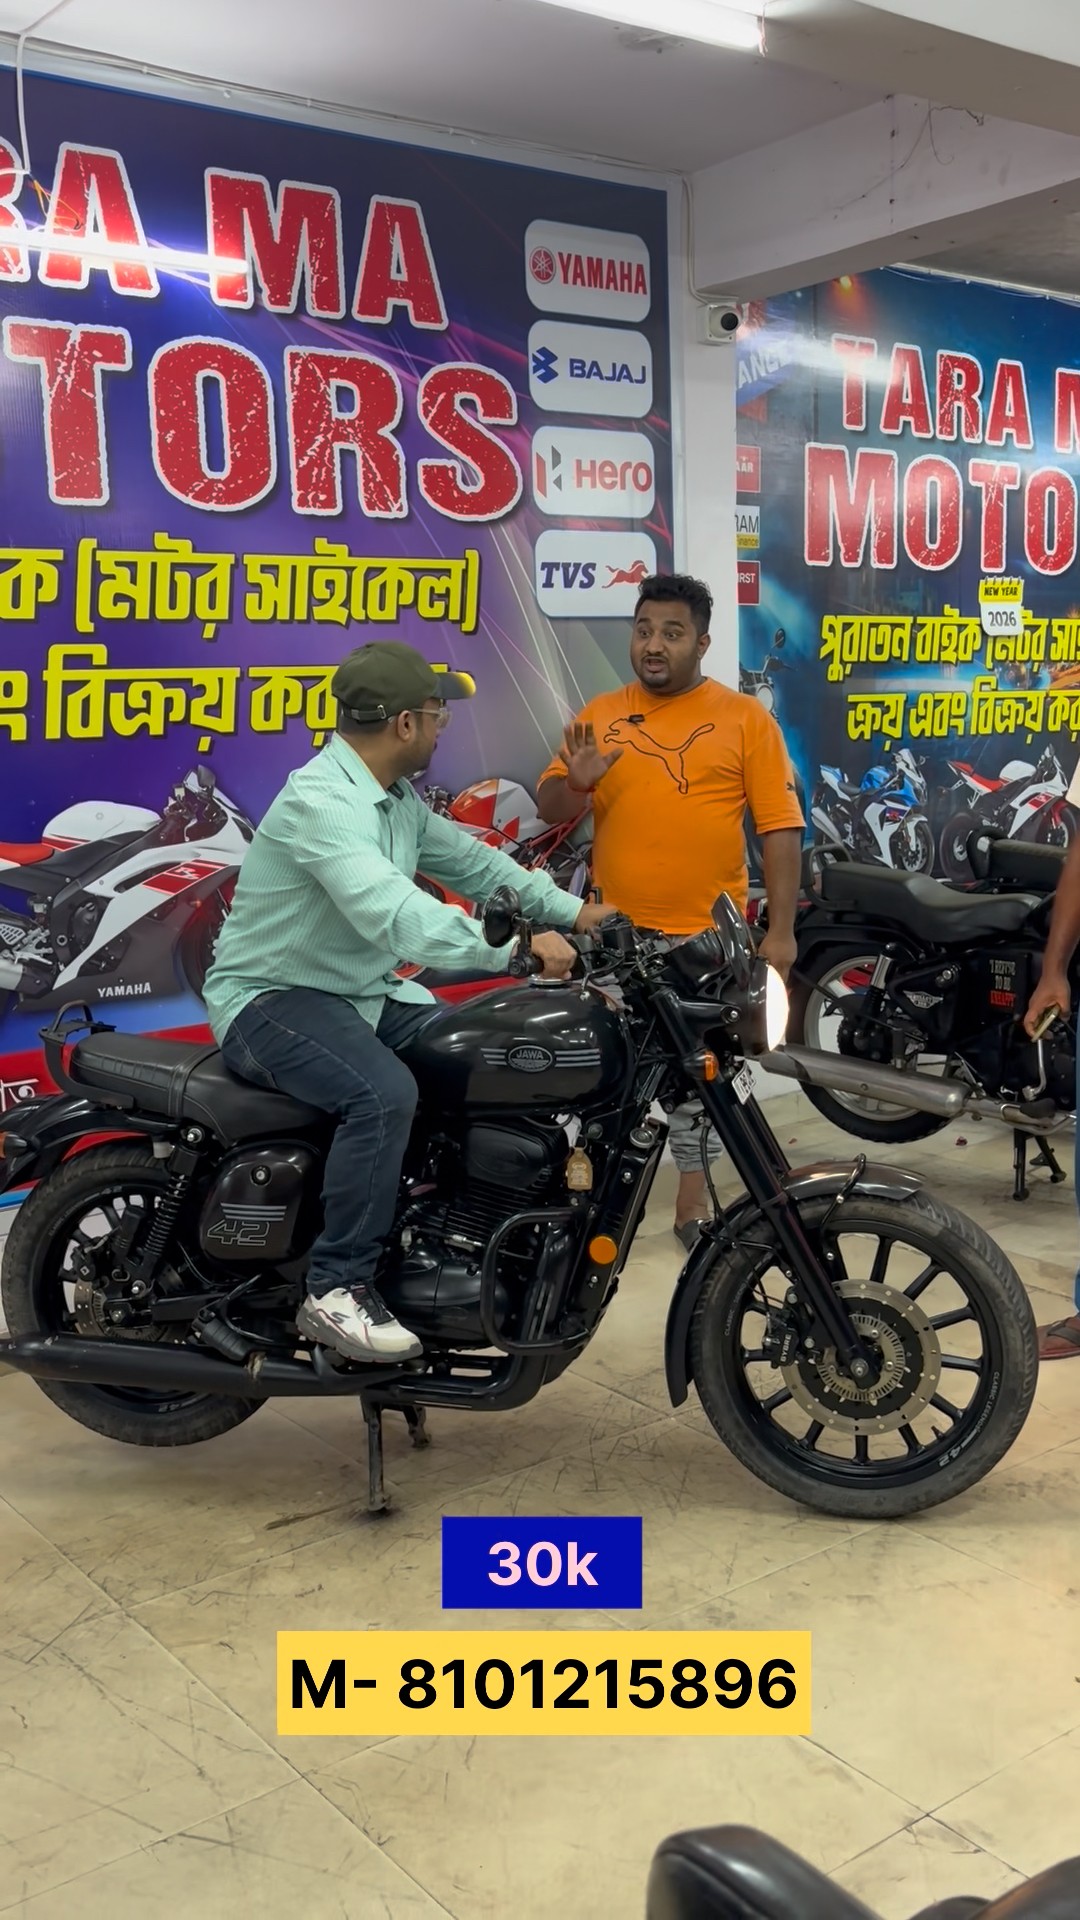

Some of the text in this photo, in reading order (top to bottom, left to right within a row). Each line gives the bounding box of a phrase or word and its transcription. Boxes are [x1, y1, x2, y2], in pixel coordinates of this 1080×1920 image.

[204, 166, 449, 331] MA
[557, 251, 648, 295] YAMAHA
[568, 357, 648, 386] BAJAJ
[831, 334, 1034, 449] TARA
[2, 315, 523, 522] TORS
[574, 457, 654, 493] Hero
[804, 442, 1078, 577] MOTO
[539, 561, 597, 590] TVS
[984, 586, 1019, 597] NEW YEAR
[987, 610, 1017, 628] 2026
[820, 614, 914, 682] পুরাতন
[915, 604, 982, 665] বাইক
[43, 643, 240, 752] বিক্রয়
[909, 691, 968, 738] এবং
[969, 675, 1047, 745] বিক্রয়
[97, 982, 152, 998] YAMAHA
[516, 1049, 544, 1060] JAWA
[207, 1219, 270, 1246] 42
